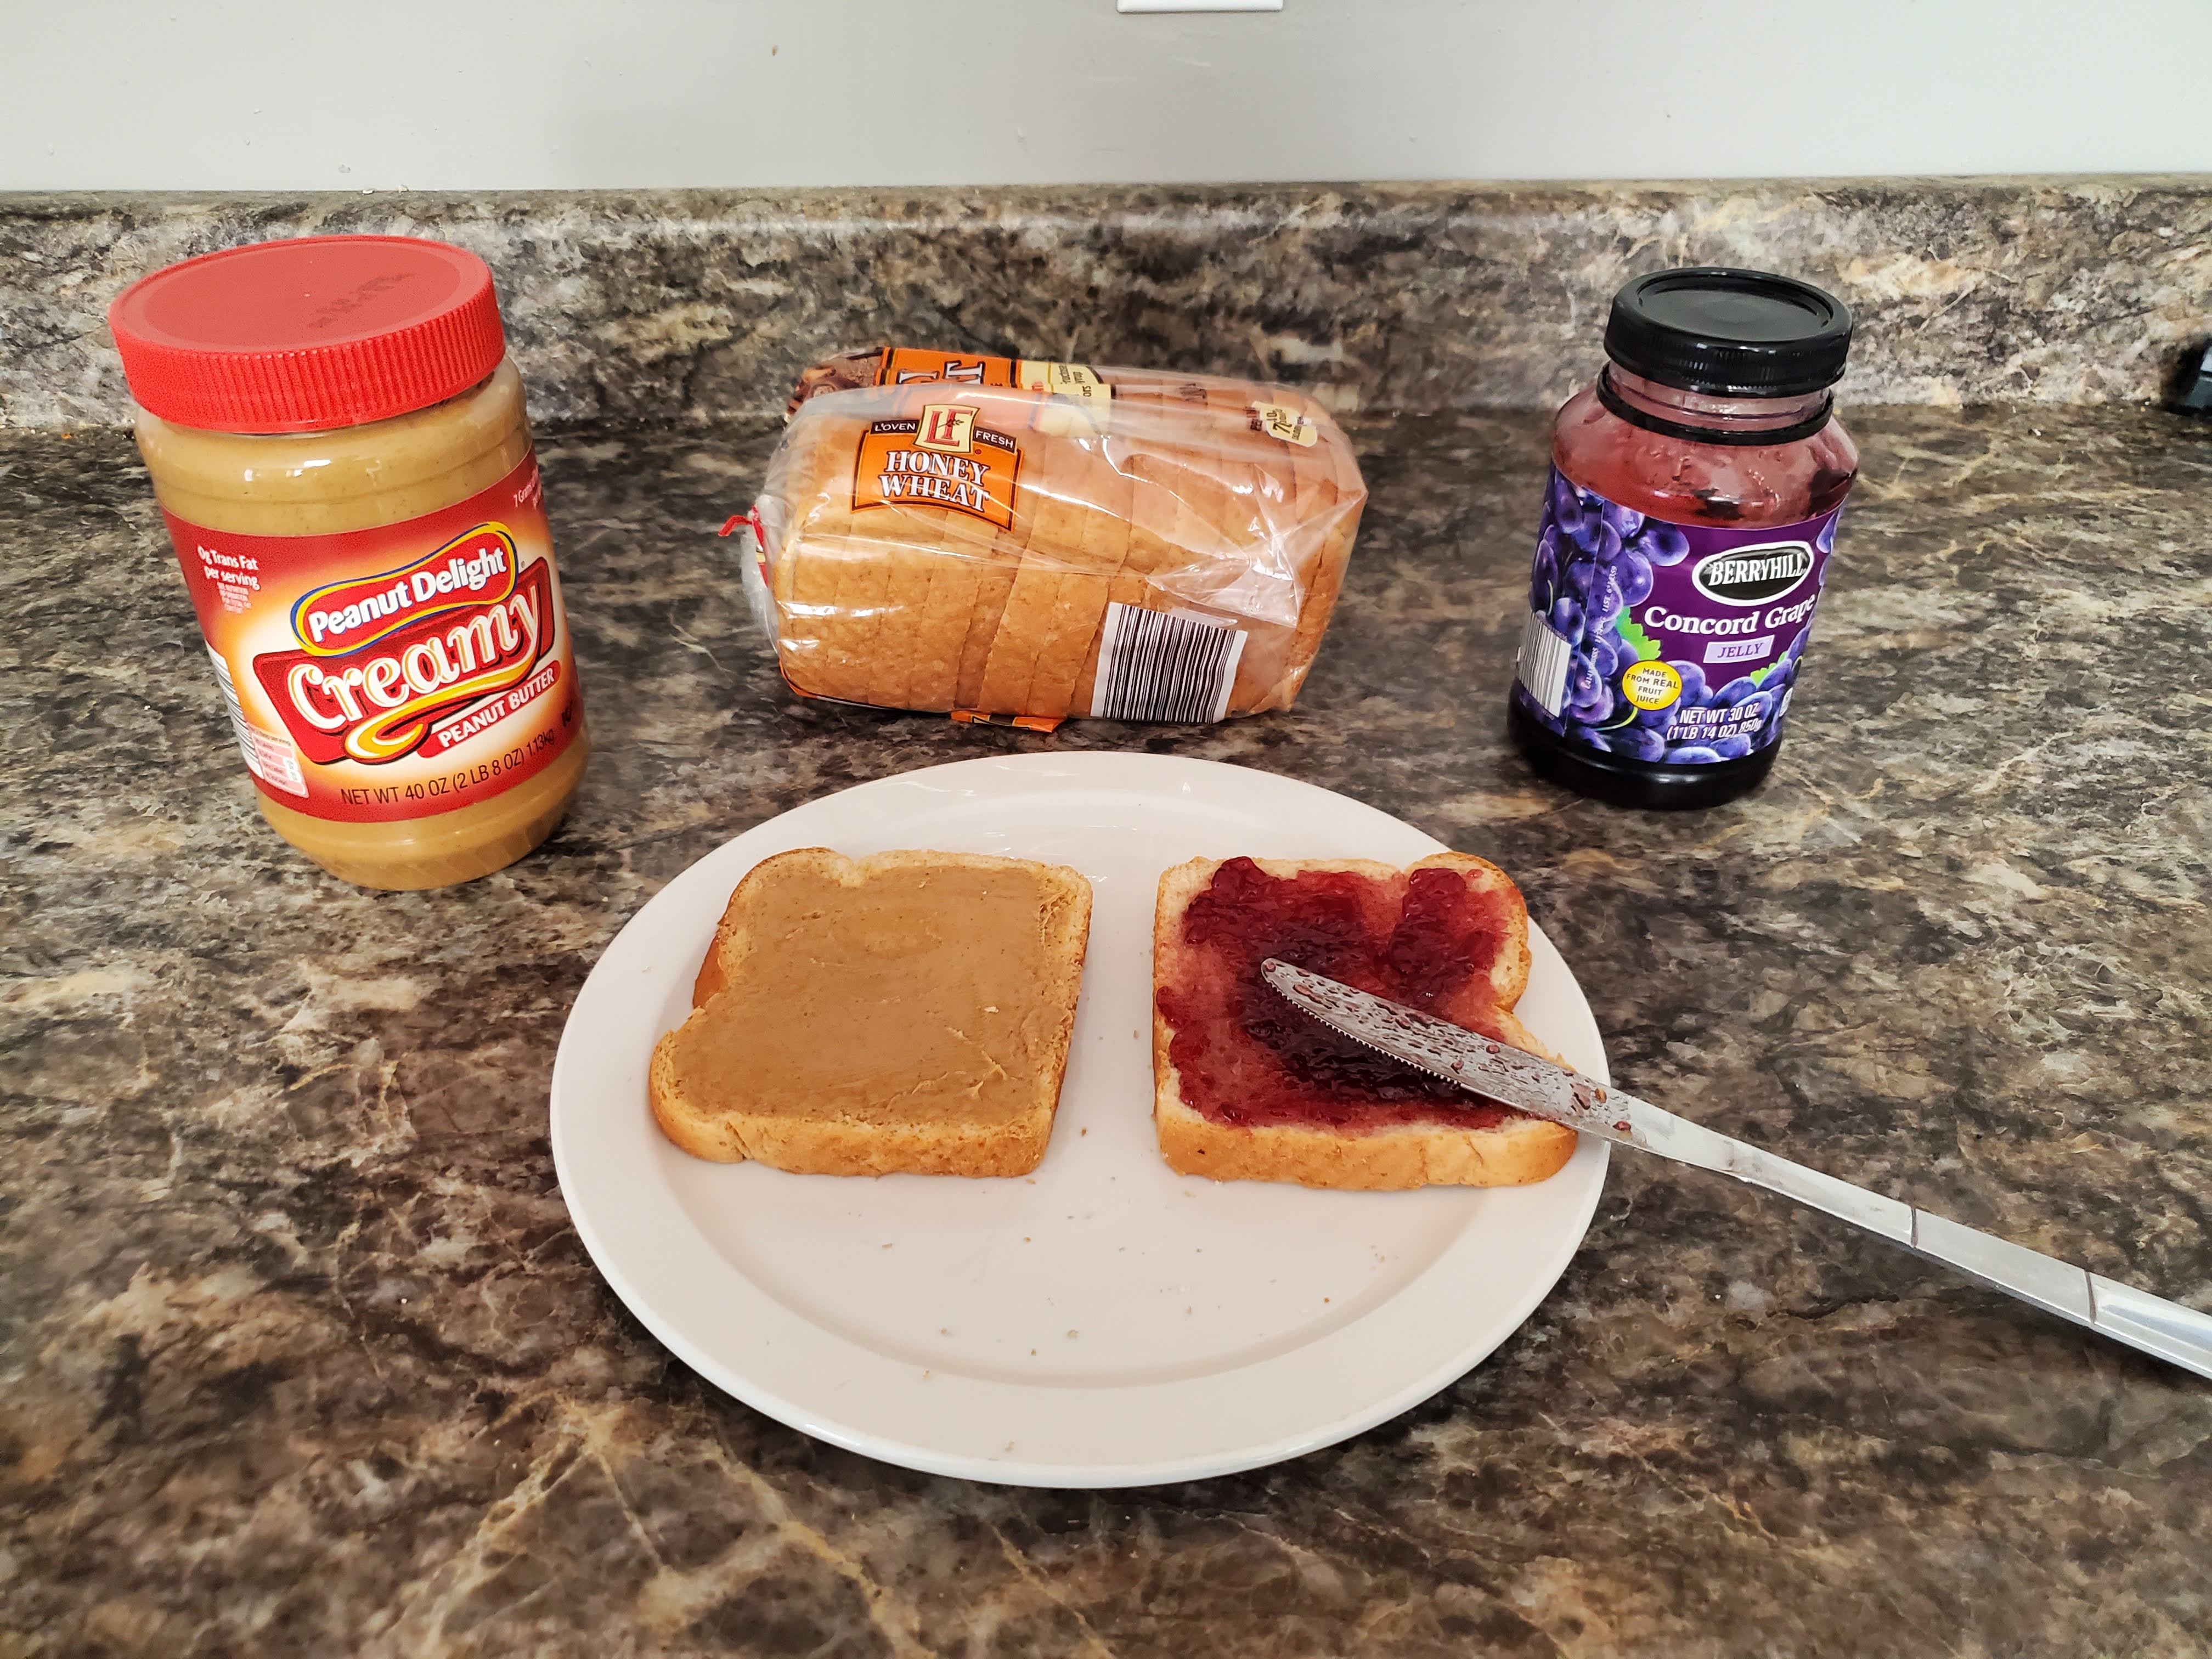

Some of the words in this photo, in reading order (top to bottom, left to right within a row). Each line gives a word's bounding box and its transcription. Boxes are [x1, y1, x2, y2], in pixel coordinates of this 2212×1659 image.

[874, 422, 916, 432] L'OVEN
[975, 430, 1014, 449] FRESH
[884, 450, 990, 486] HONEY
[878, 475, 990, 512] WHEAT
[209, 549, 240, 568] Trans
[239, 554, 259, 571] Fat
[1707, 552, 1804, 586] BERRYHILL
[204, 566, 219, 580] per
[220, 571, 261, 591] serving
[308, 583, 413, 642] Peanut
[410, 547, 507, 602] Delight
[1644, 606, 1760, 636] Concord
[1764, 594, 1815, 629] Grape
[287, 584, 538, 730] Creamy
[1717, 642, 1764, 659] JELLY
[1626, 673, 1650, 685] FROM
[1652, 678, 1679, 690] REAL
[1642, 667, 1667, 678] MADE
[1635, 695, 1660, 705] JUICE
[1637, 686, 1663, 696] FRUIT
[437, 699, 505, 748] PEANUT
[508, 668, 555, 710] BUTTER
[1679, 709, 1706, 725] NET
[1706, 708, 1729, 724] WT
[1728, 706, 1743, 722] 30
[1743, 702, 1760, 719] OZ
[1666, 725, 1679, 741] (1
[1680, 725, 1699, 740] LB
[1701, 725, 1718, 740] 14
[1718, 722, 1738, 738] OZ)
[1737, 717, 1763, 735] 850g
[341, 788, 369, 805] NET
[373, 787, 399, 804] WT
[405, 783, 425, 800] 40
[428, 777, 450, 795] OZ
[453, 775, 469, 793] (2
[470, 765, 489, 788] LB
[492, 760, 501, 776] 8
[504, 747, 525, 771] OZ)
[526, 728, 555, 756] 1.13kg
